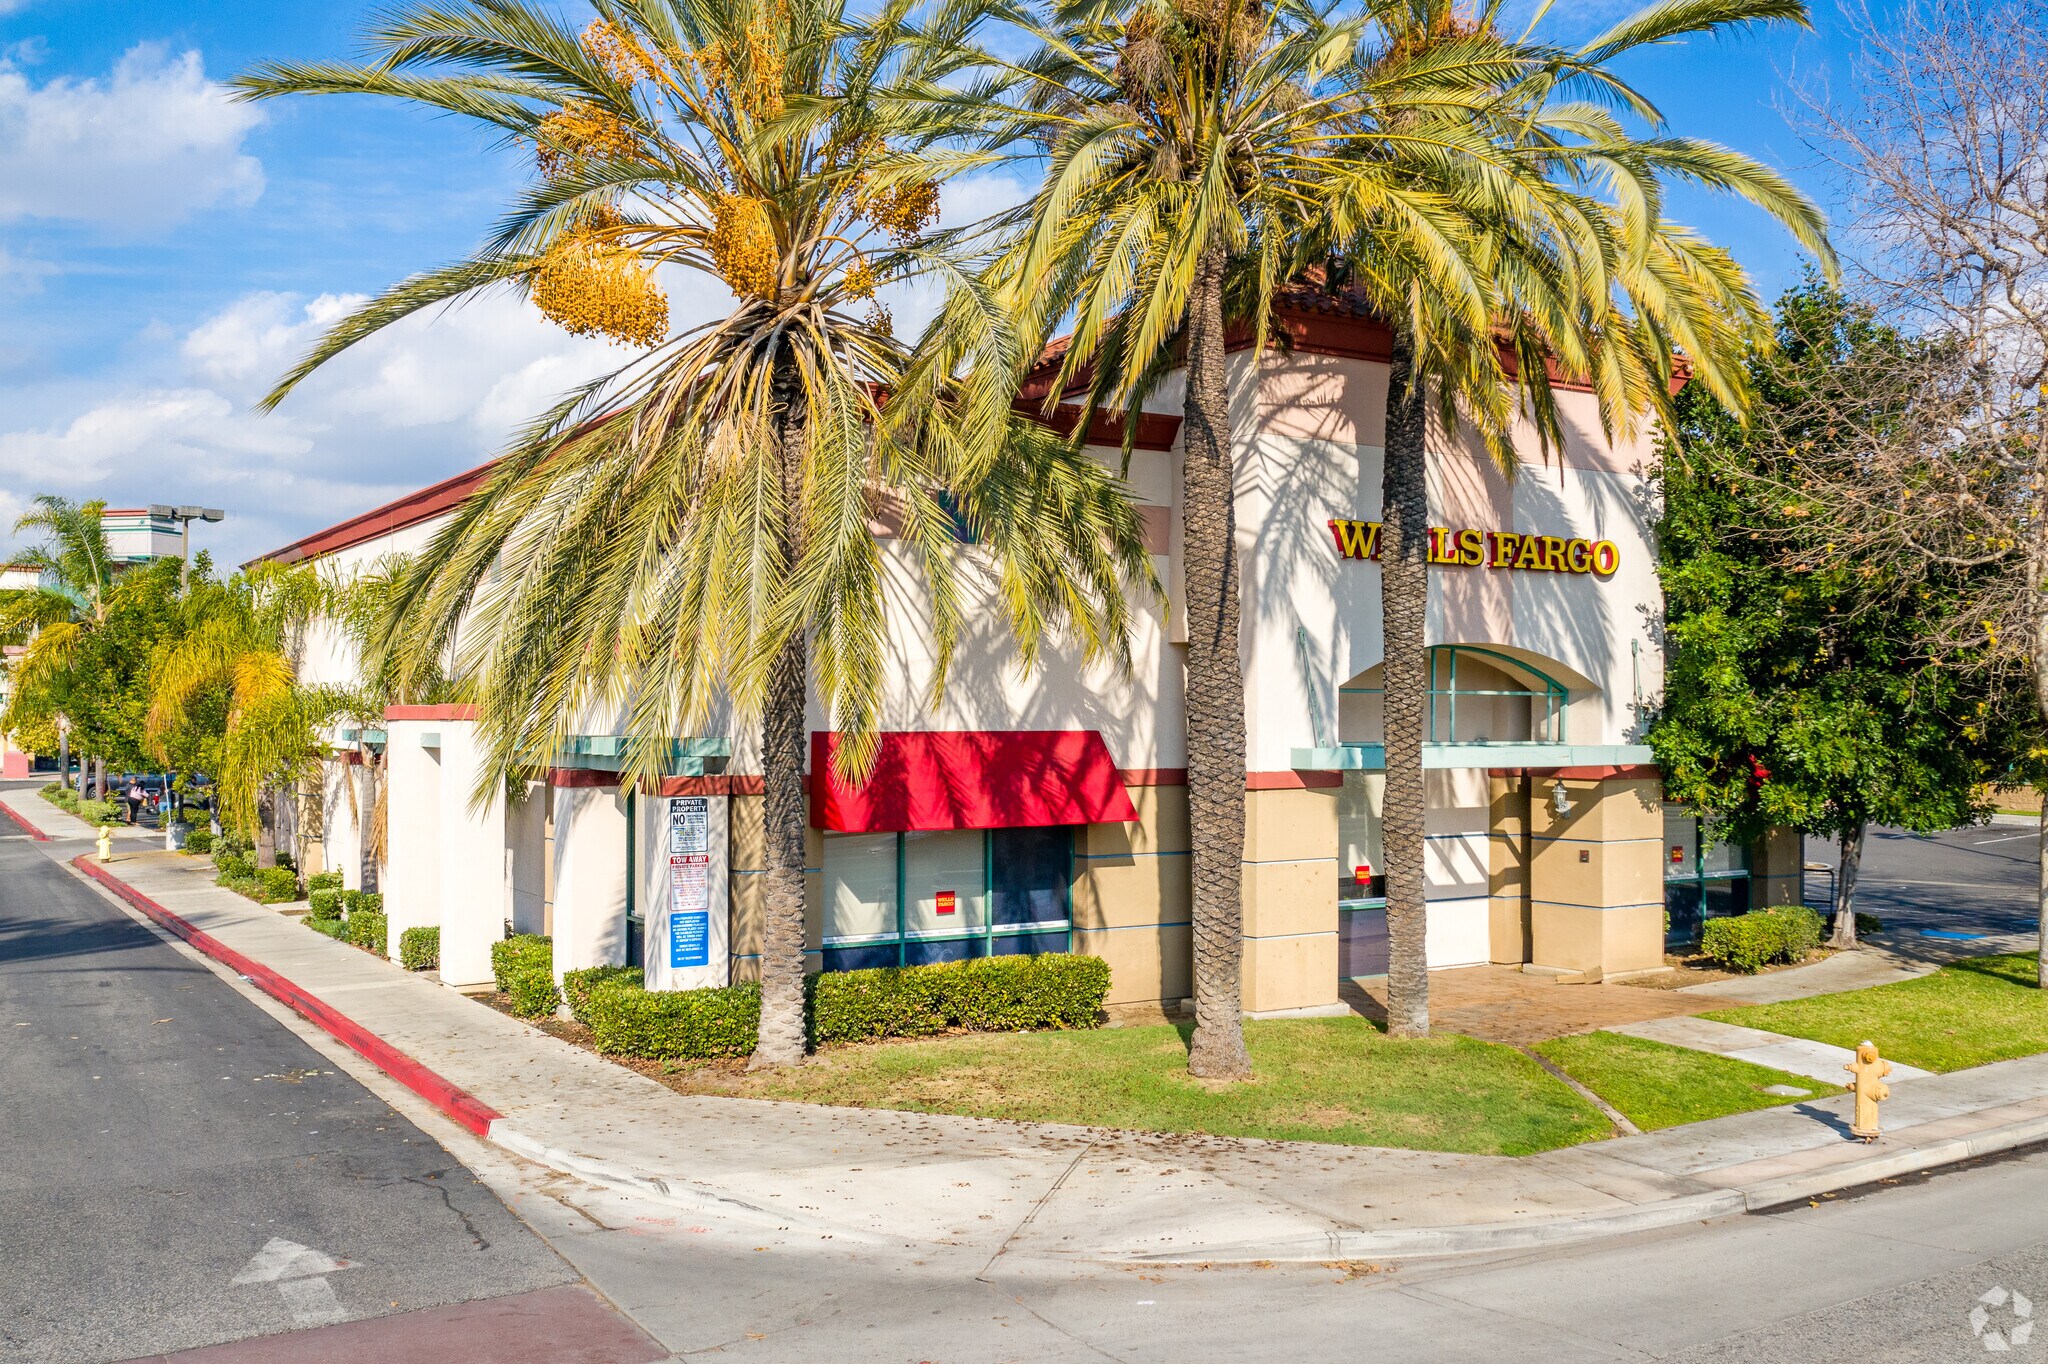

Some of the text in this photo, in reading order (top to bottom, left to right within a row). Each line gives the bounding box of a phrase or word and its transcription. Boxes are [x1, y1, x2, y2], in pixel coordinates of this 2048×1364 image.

[1328, 519, 1621, 577] WLS FARGO
[672, 814, 685, 825] NO
